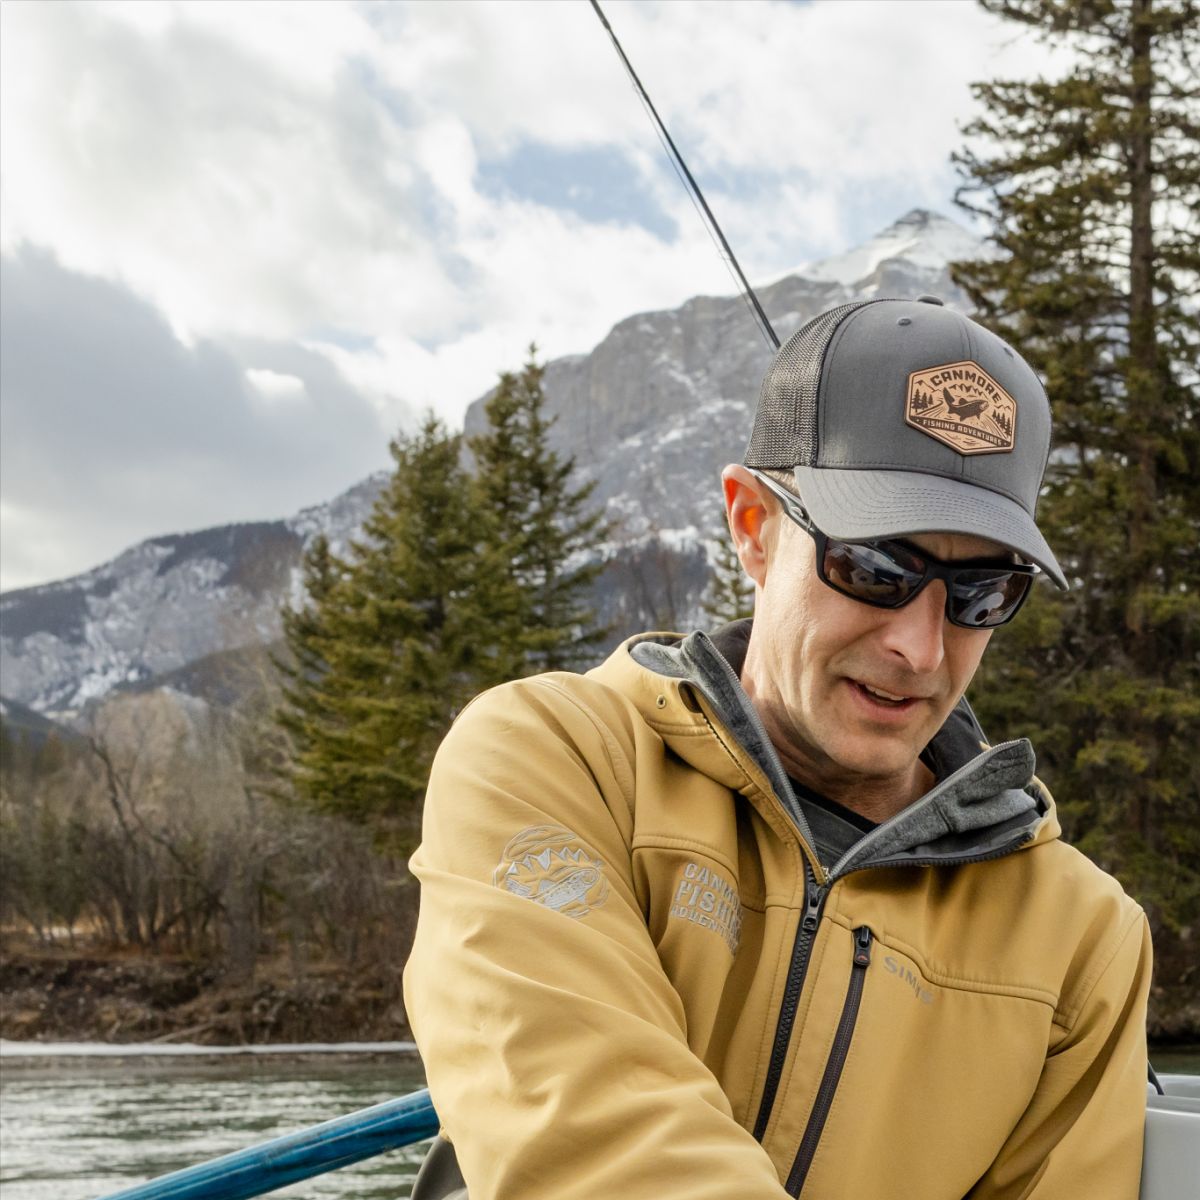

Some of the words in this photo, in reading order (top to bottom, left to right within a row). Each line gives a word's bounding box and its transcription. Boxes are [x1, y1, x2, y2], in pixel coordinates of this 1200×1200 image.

[930, 370, 1002, 403] CANMORE
[922, 420, 956, 431] FISHING
[957, 426, 1002, 446] ADVENTURES
[684, 863, 742, 916] CANM
